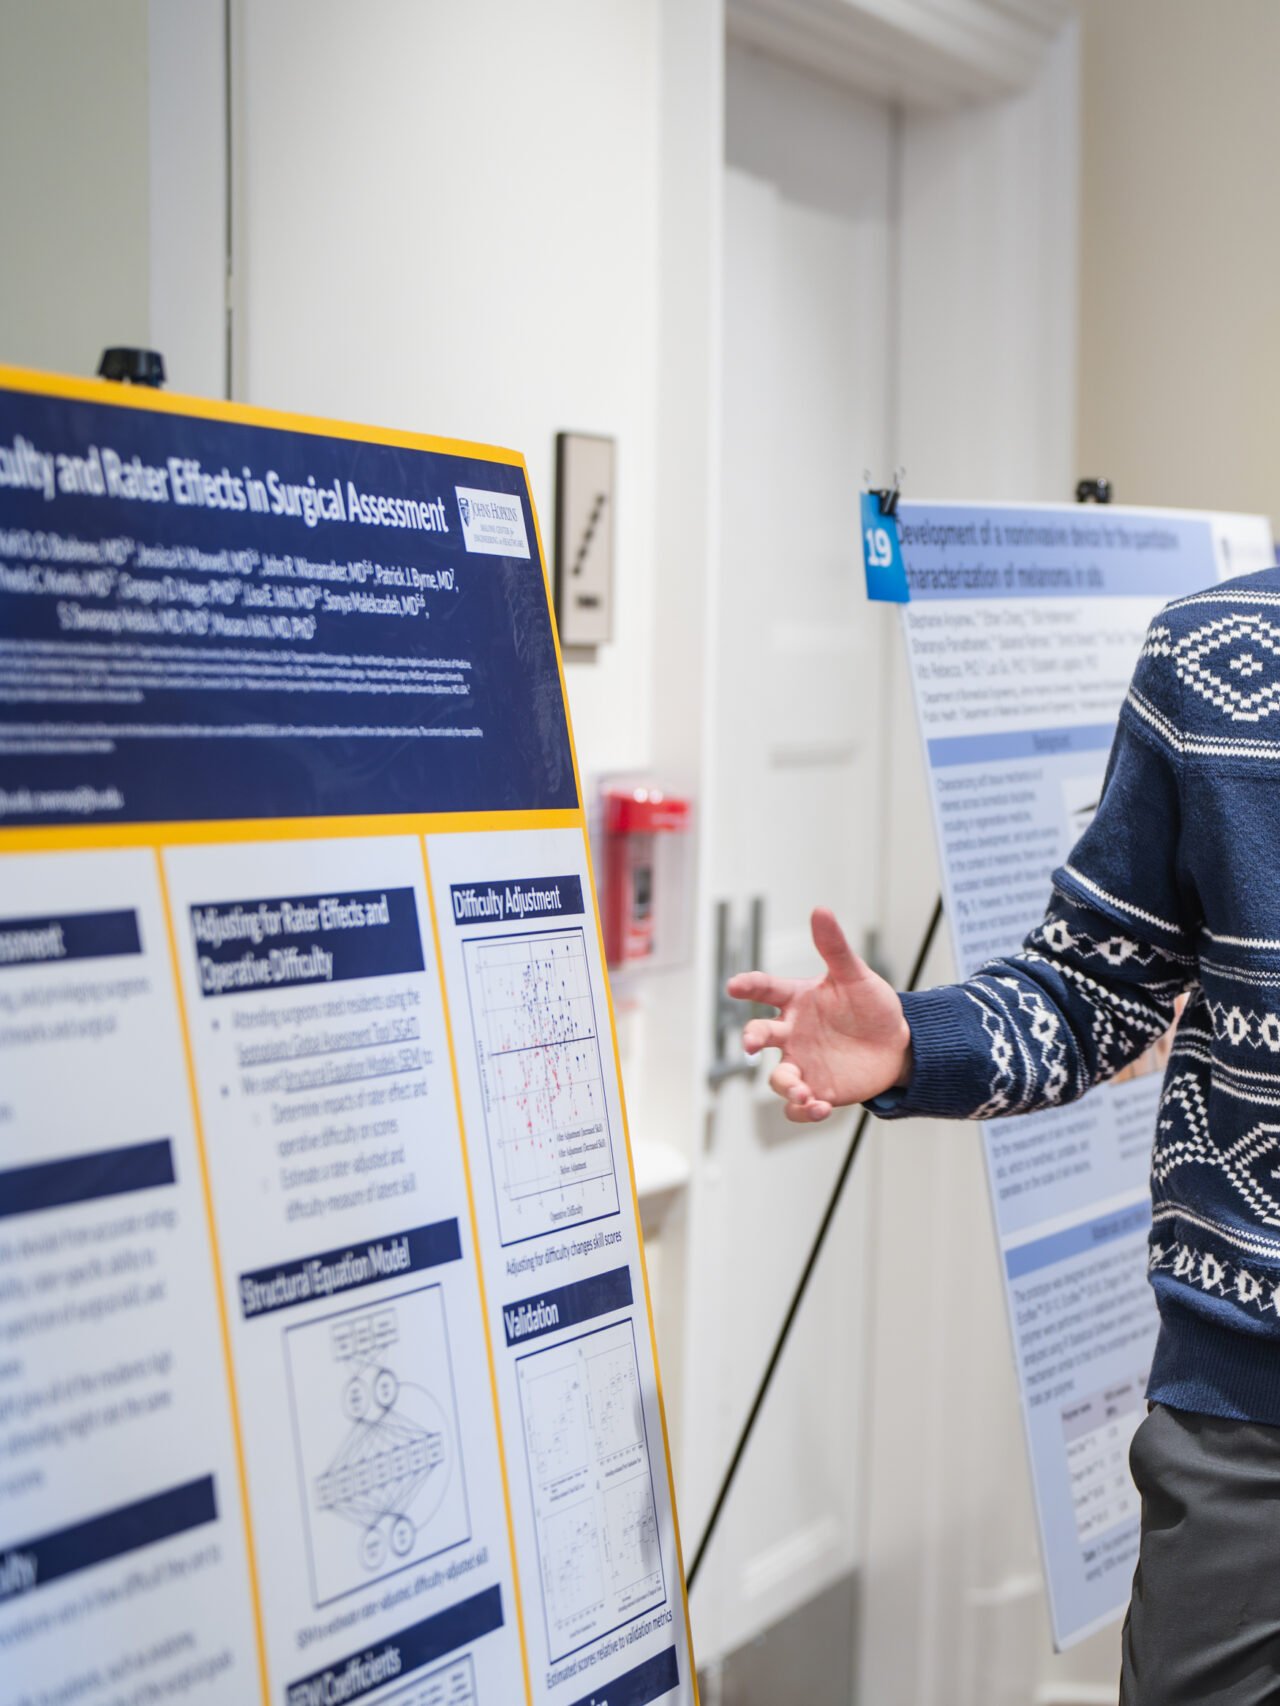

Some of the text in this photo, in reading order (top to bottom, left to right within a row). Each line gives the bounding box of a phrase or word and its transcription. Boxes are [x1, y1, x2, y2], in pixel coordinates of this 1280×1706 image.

[56, 444, 107, 496] and
[101, 447, 169, 502] Rater
[167, 456, 247, 511] Effects
[266, 469, 346, 528] Surgical
[347, 481, 449, 533] Assessment
[865, 528, 893, 568] 19
[364, 893, 390, 926] and
[452, 885, 562, 920] Difficulty Adjustment
[268, 944, 334, 982] Difficulty
[309, 1252, 371, 1296] Equation
[367, 1236, 411, 1277] Model
[544, 1244, 571, 1265] difficulty
[569, 1238, 594, 1258] changes
[592, 1231, 606, 1251] skill
[604, 1229, 622, 1247] scores
[504, 1300, 560, 1340] Validation
[546, 1659, 578, 1691] Estimated
[576, 1651, 598, 1673] scores
[595, 1641, 619, 1665] relative
[617, 1638, 626, 1652] to
[624, 1619, 653, 1648] validation
[651, 1608, 674, 1631] metrics
